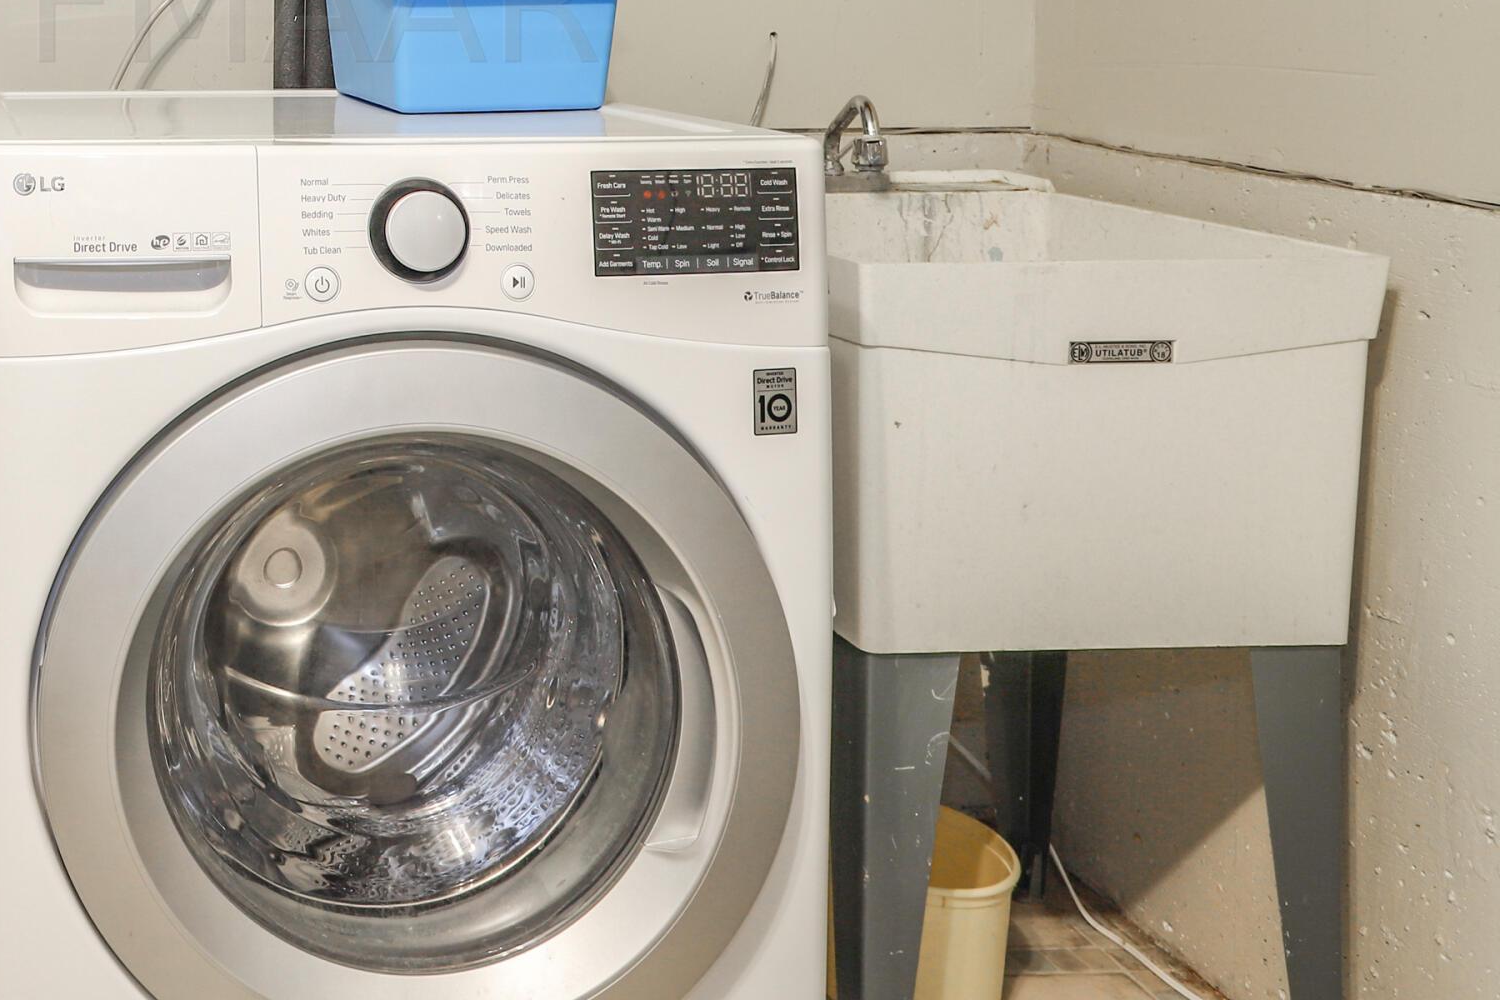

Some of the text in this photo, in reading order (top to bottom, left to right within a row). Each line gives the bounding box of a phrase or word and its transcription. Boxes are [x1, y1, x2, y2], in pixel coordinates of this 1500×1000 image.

[300, 178, 329, 186] Normal
[511, 176, 530, 184] Press
[301, 193, 347, 203] Heavy Duty
[495, 191, 531, 200] Delicates
[301, 210, 334, 219] Bedding
[504, 208, 532, 216] Towels
[302, 228, 331, 237] Whites
[485, 225, 532, 235] Speed Wash
[73, 241, 138, 253] Direct Drive
[303, 246, 342, 255] Tub Clean
[485, 243, 533, 252] Downloaded
[642, 260, 663, 269] Temp.
[674, 259, 690, 269] Spin
[706, 258, 720, 267] Soil
[733, 257, 754, 267] Signal
[757, 376, 793, 385] Direct Drive
[758, 393, 792, 423] 10
